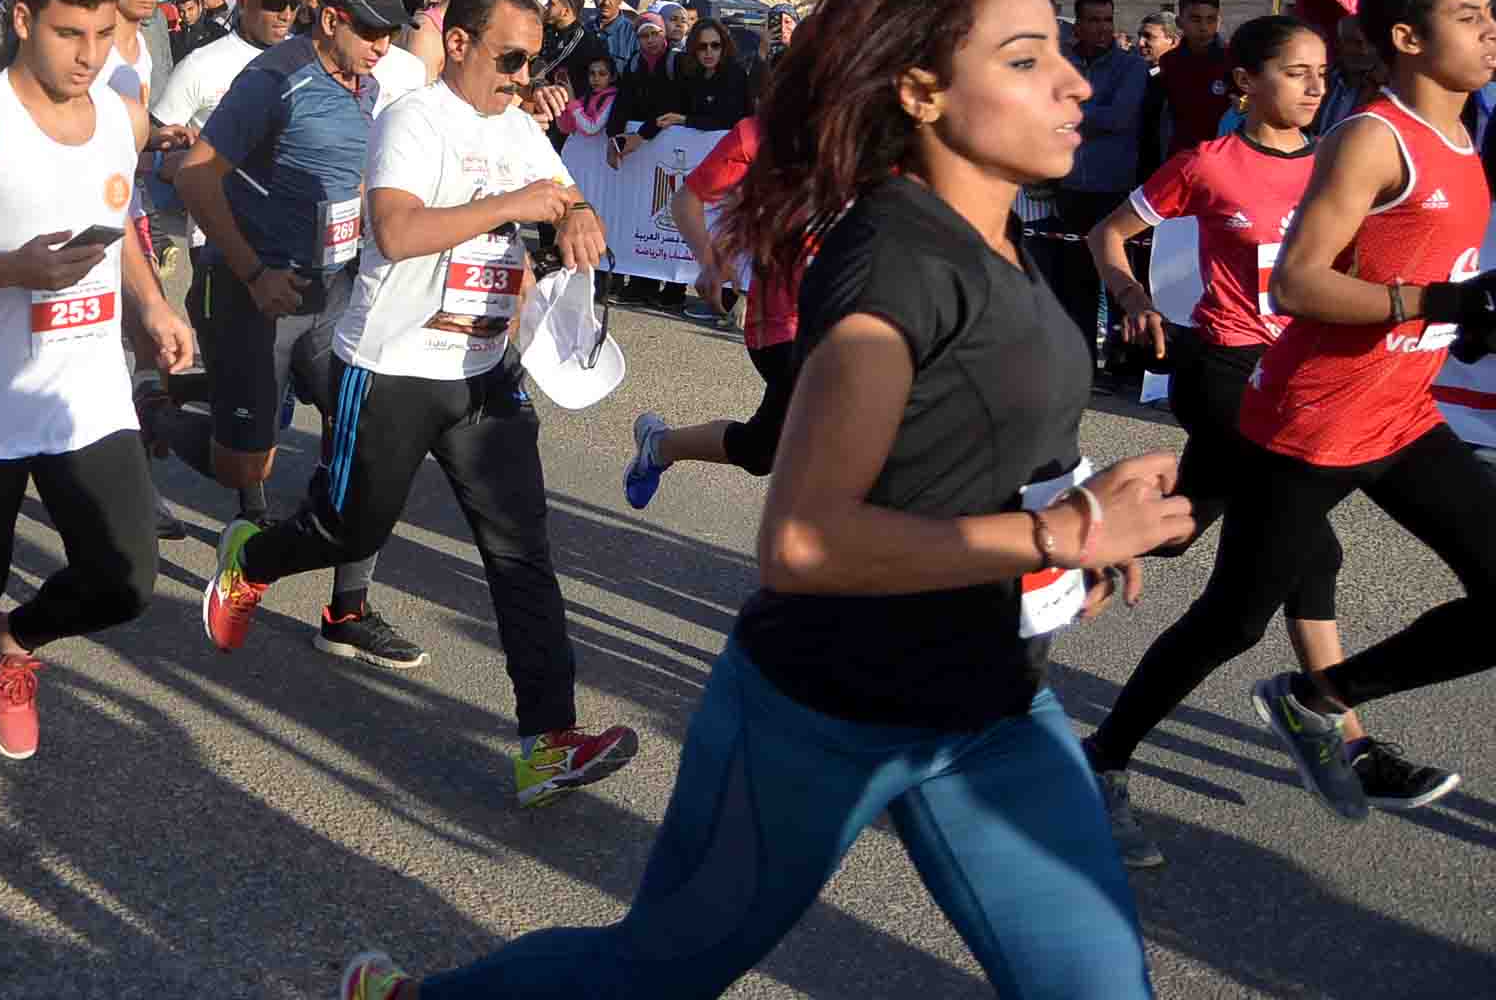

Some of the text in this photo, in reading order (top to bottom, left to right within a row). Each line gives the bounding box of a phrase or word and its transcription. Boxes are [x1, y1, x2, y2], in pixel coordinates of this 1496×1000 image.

[332, 221, 355, 242] 269
[464, 266, 509, 290] 283
[50, 297, 102, 327] 253
